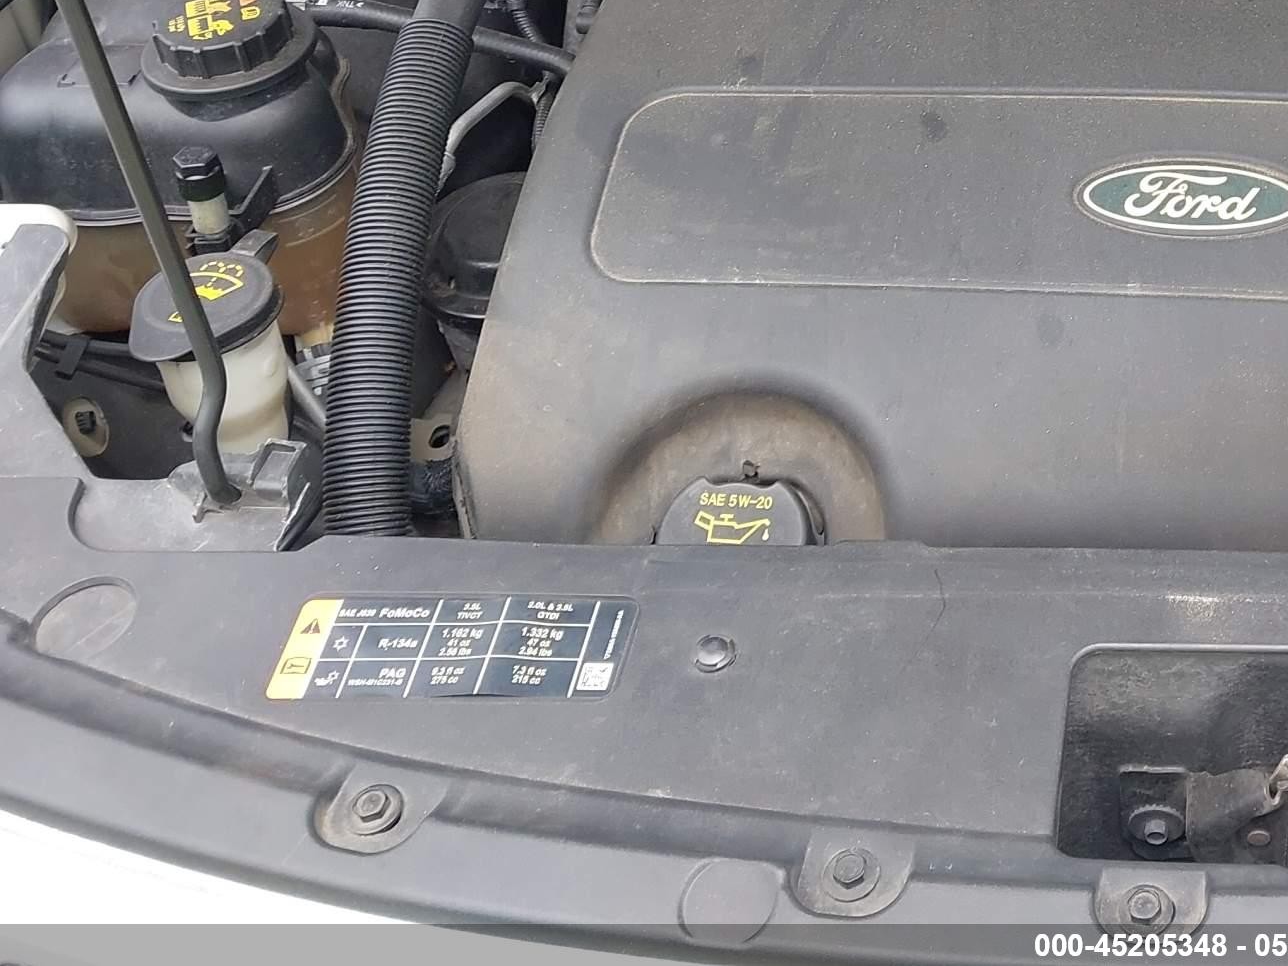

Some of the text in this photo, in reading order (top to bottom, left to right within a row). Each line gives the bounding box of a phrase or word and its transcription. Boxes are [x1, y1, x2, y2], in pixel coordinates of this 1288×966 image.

[1124, 172, 1260, 220] Ford
[699, 491, 773, 510] SAE 5W-20
[379, 607, 430, 618] FoMoCo
[470, 628, 484, 639] kg
[550, 628, 564, 641] kg
[527, 638, 539, 646] 47
[379, 668, 406, 678] PAG
[512, 665, 527, 675] 7.3
